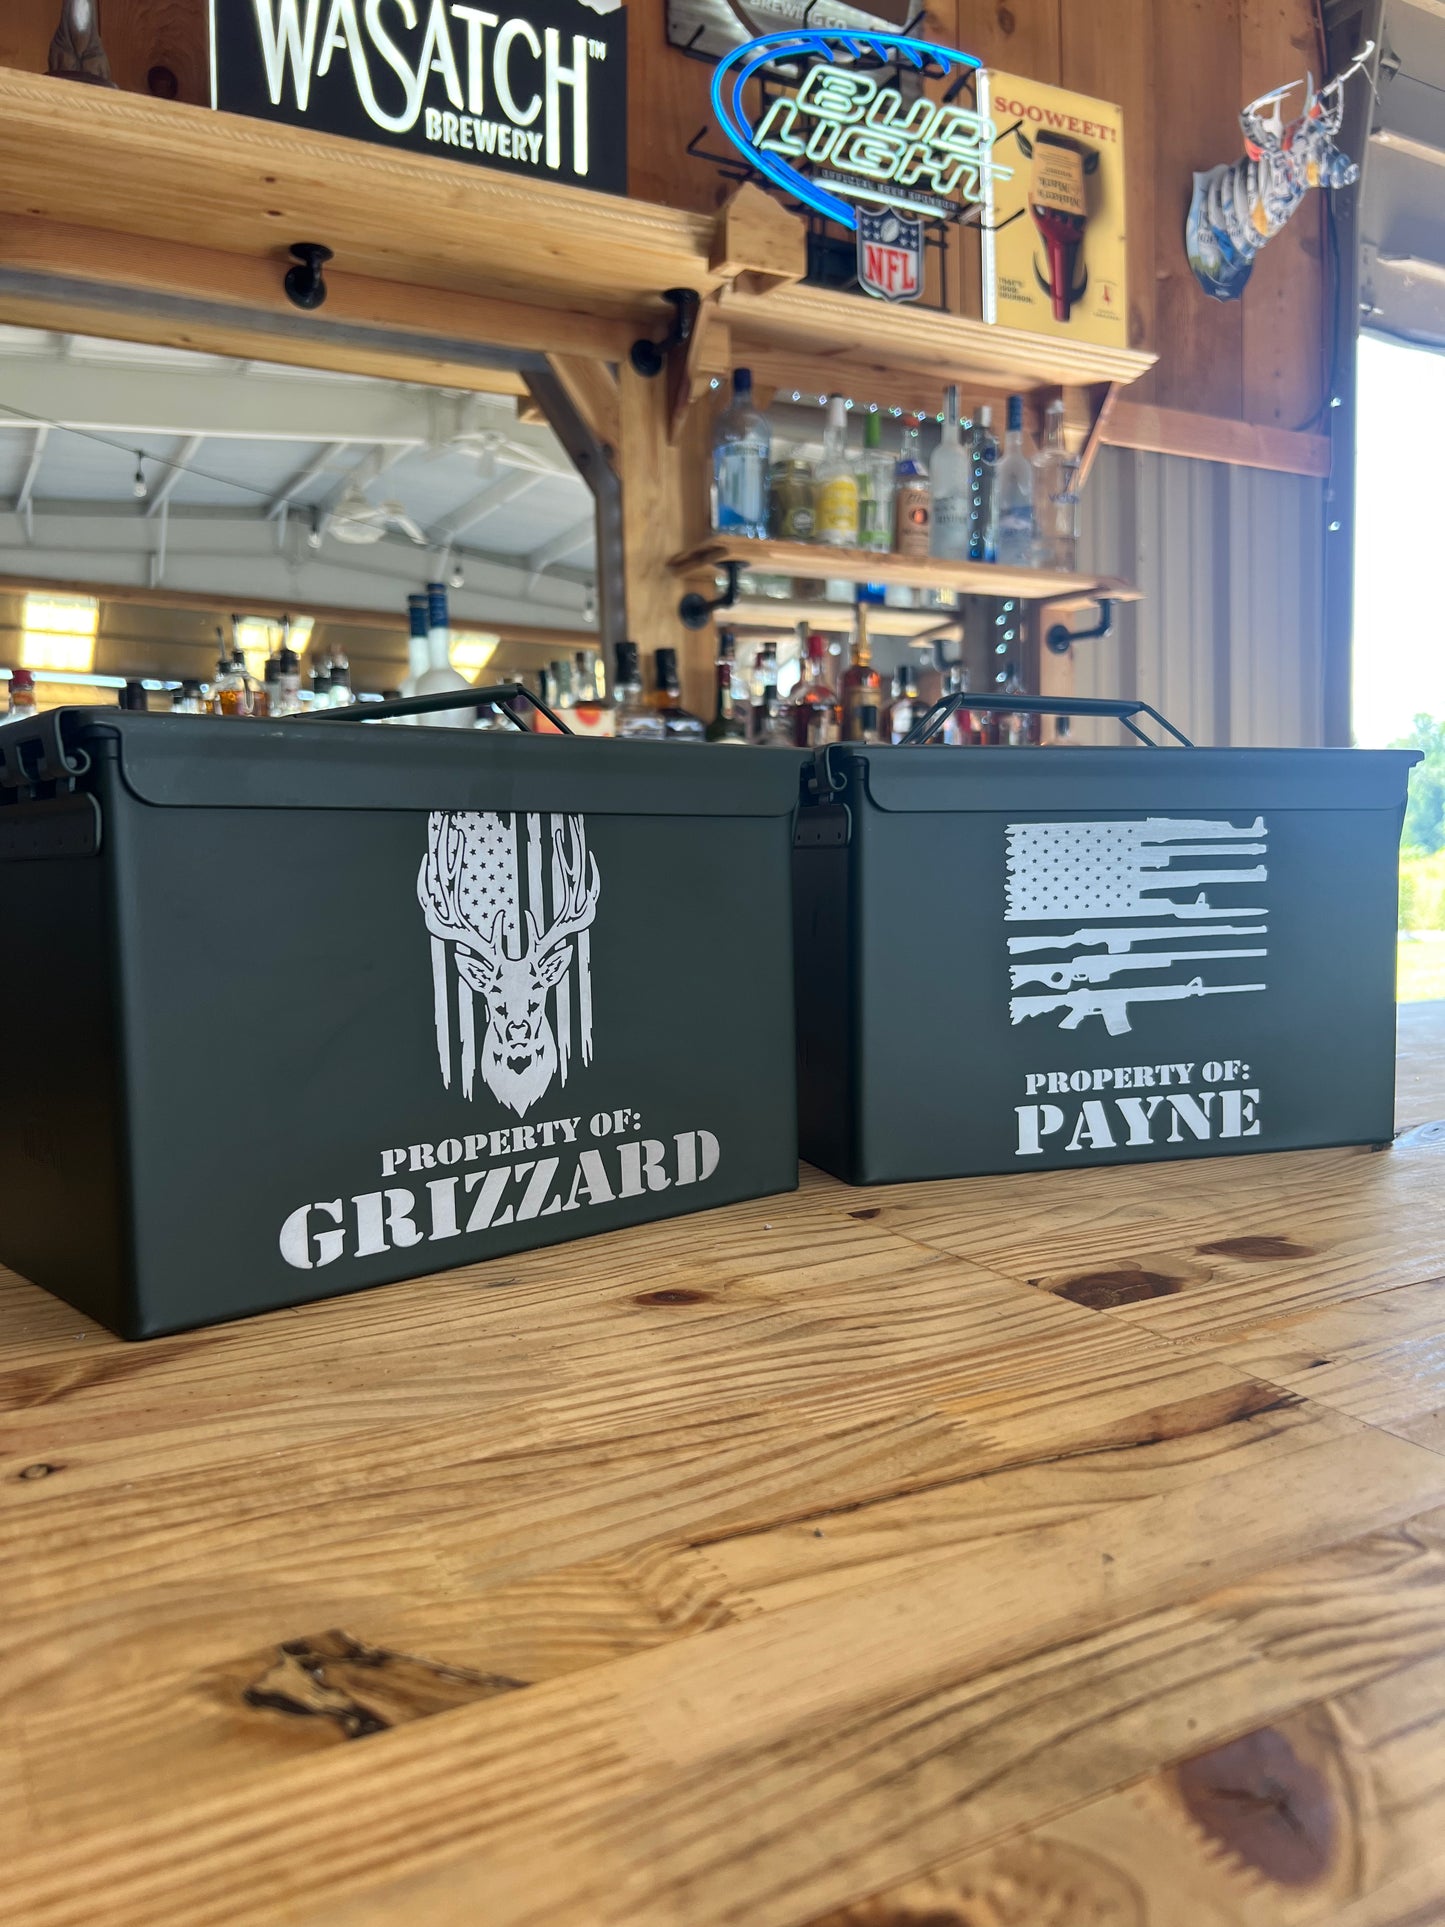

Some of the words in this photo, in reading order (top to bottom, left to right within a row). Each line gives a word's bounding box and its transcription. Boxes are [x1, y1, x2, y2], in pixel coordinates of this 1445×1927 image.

[251, 0, 588, 175] WASATCH
[797, 64, 996, 157] BUD
[994, 96, 1117, 143] SOOWEET!
[425, 106, 543, 164] BREWERY
[752, 97, 1014, 203] LIGHT
[865, 244, 915, 293] NFL
[1025, 1063, 1195, 1096] PROPERTY
[1202, 1060, 1250, 1083] OF:
[380, 1116, 582, 1177] PROPERTY
[589, 1108, 642, 1137] OF:
[1014, 1088, 1261, 1156] PAYNE
[279, 1129, 721, 1270] GRIZZARD
